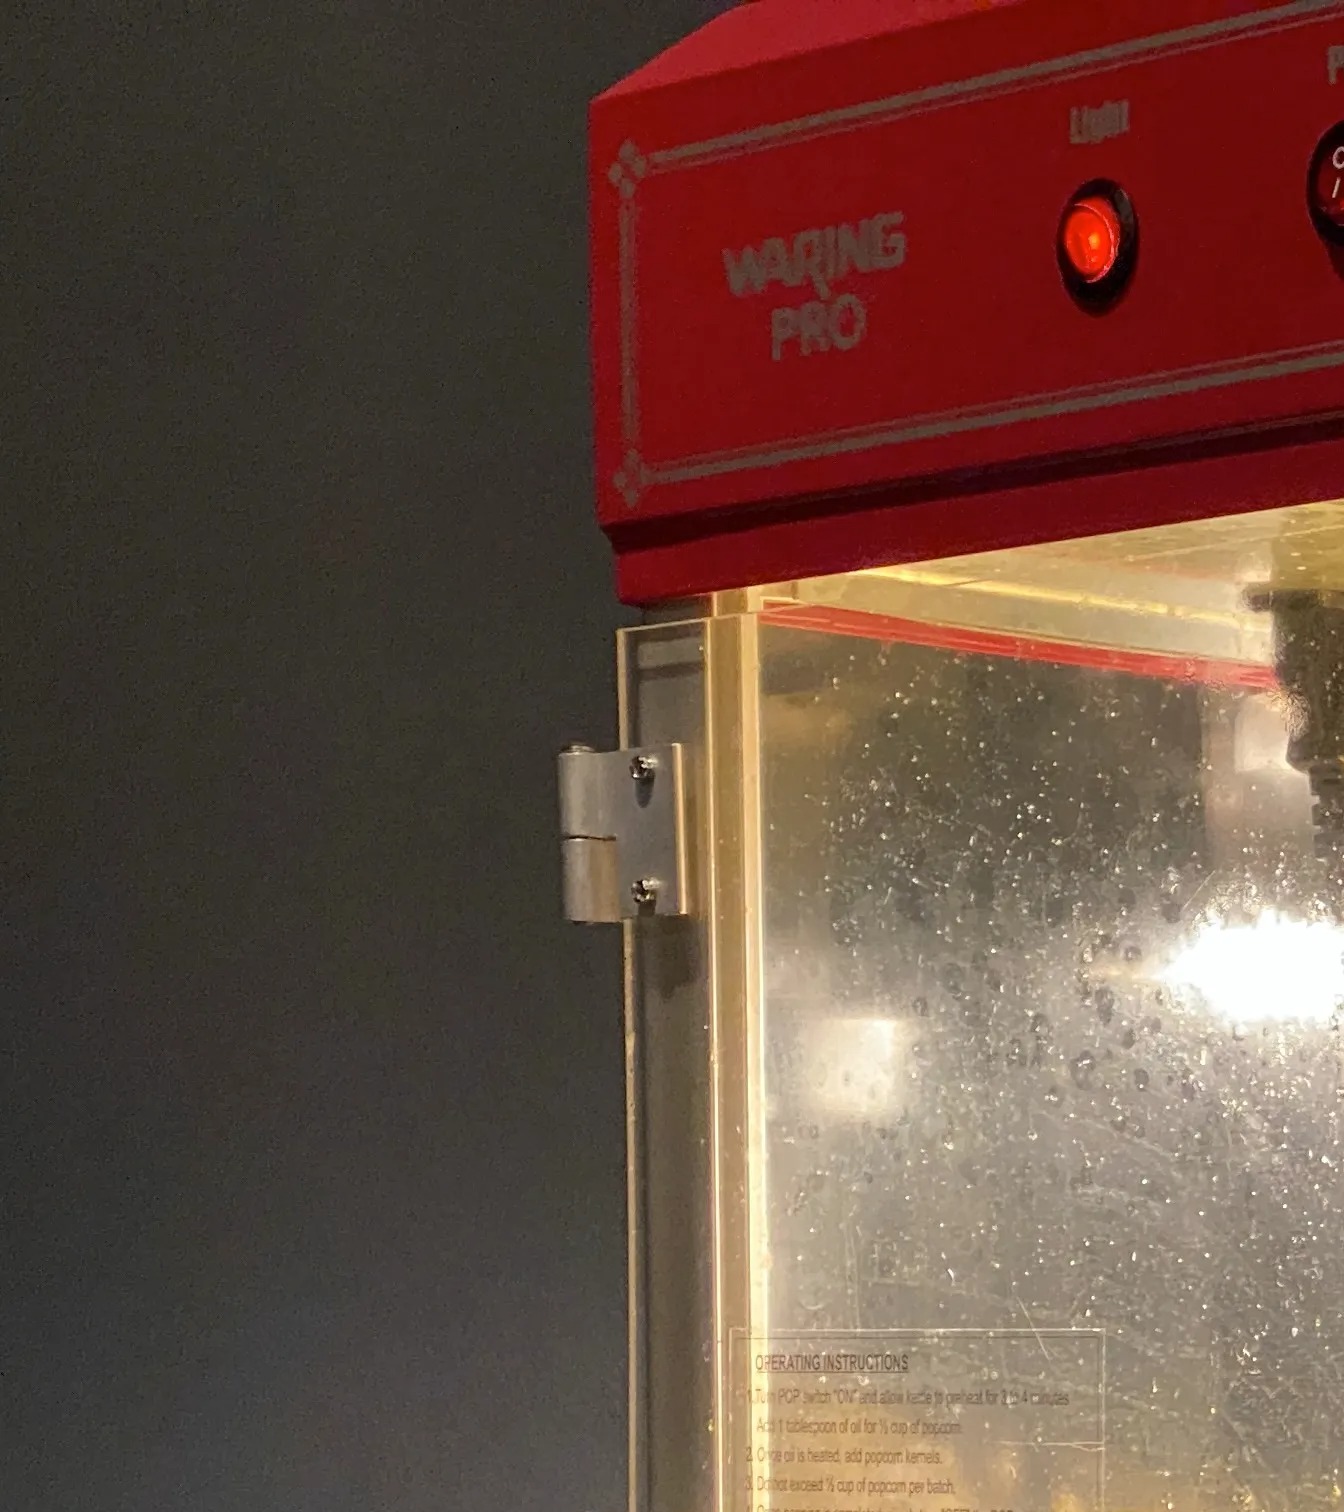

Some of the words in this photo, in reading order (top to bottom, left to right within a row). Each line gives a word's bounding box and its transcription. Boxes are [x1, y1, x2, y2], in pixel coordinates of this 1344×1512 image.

[722, 211, 906, 299] WARING
[771, 294, 866, 362] PRO
[755, 1353, 821, 1372] OPERATING
[823, 1353, 909, 1372] INSTRUCTIONS
[836, 1479, 855, 1496] cup
[856, 1477, 867, 1493] of
